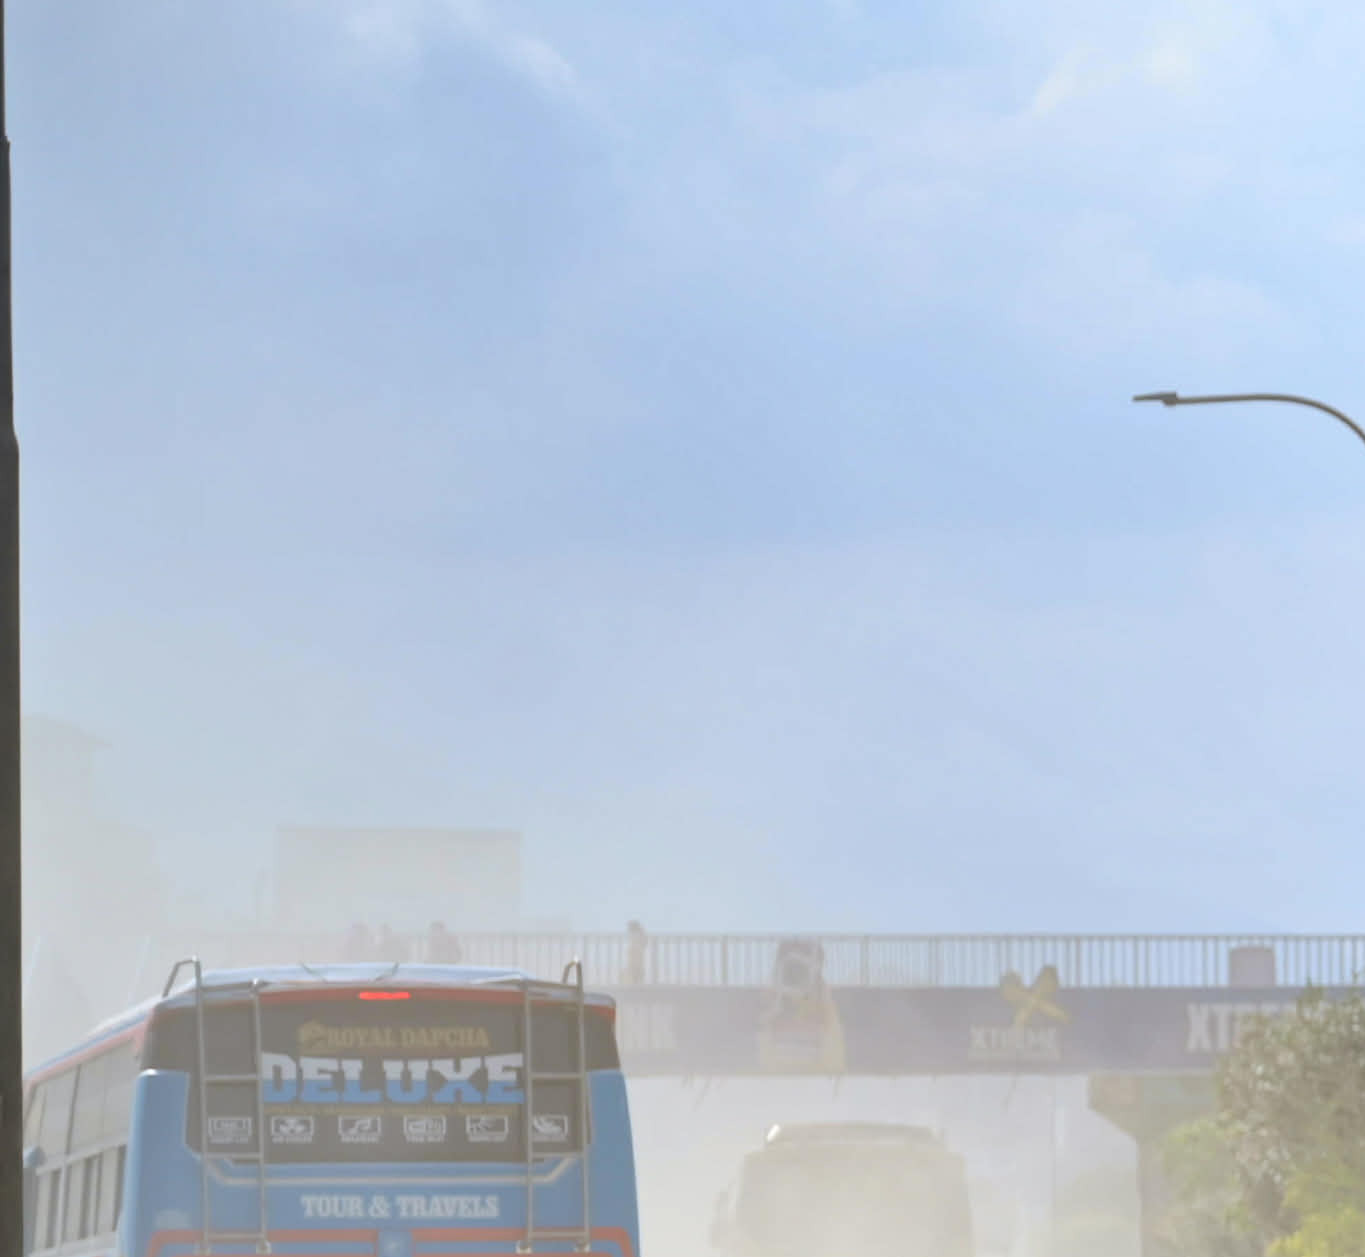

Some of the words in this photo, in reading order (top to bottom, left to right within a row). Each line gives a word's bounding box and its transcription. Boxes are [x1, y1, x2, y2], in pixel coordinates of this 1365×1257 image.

[327, 1026, 396, 1048] ROYAL
[400, 1026, 490, 1048] DAPCHA
[261, 1052, 525, 1104] DELUXE
[301, 1195, 365, 1218] TOUR
[368, 1195, 390, 1218] &
[397, 1195, 500, 1218] TRAVELS
